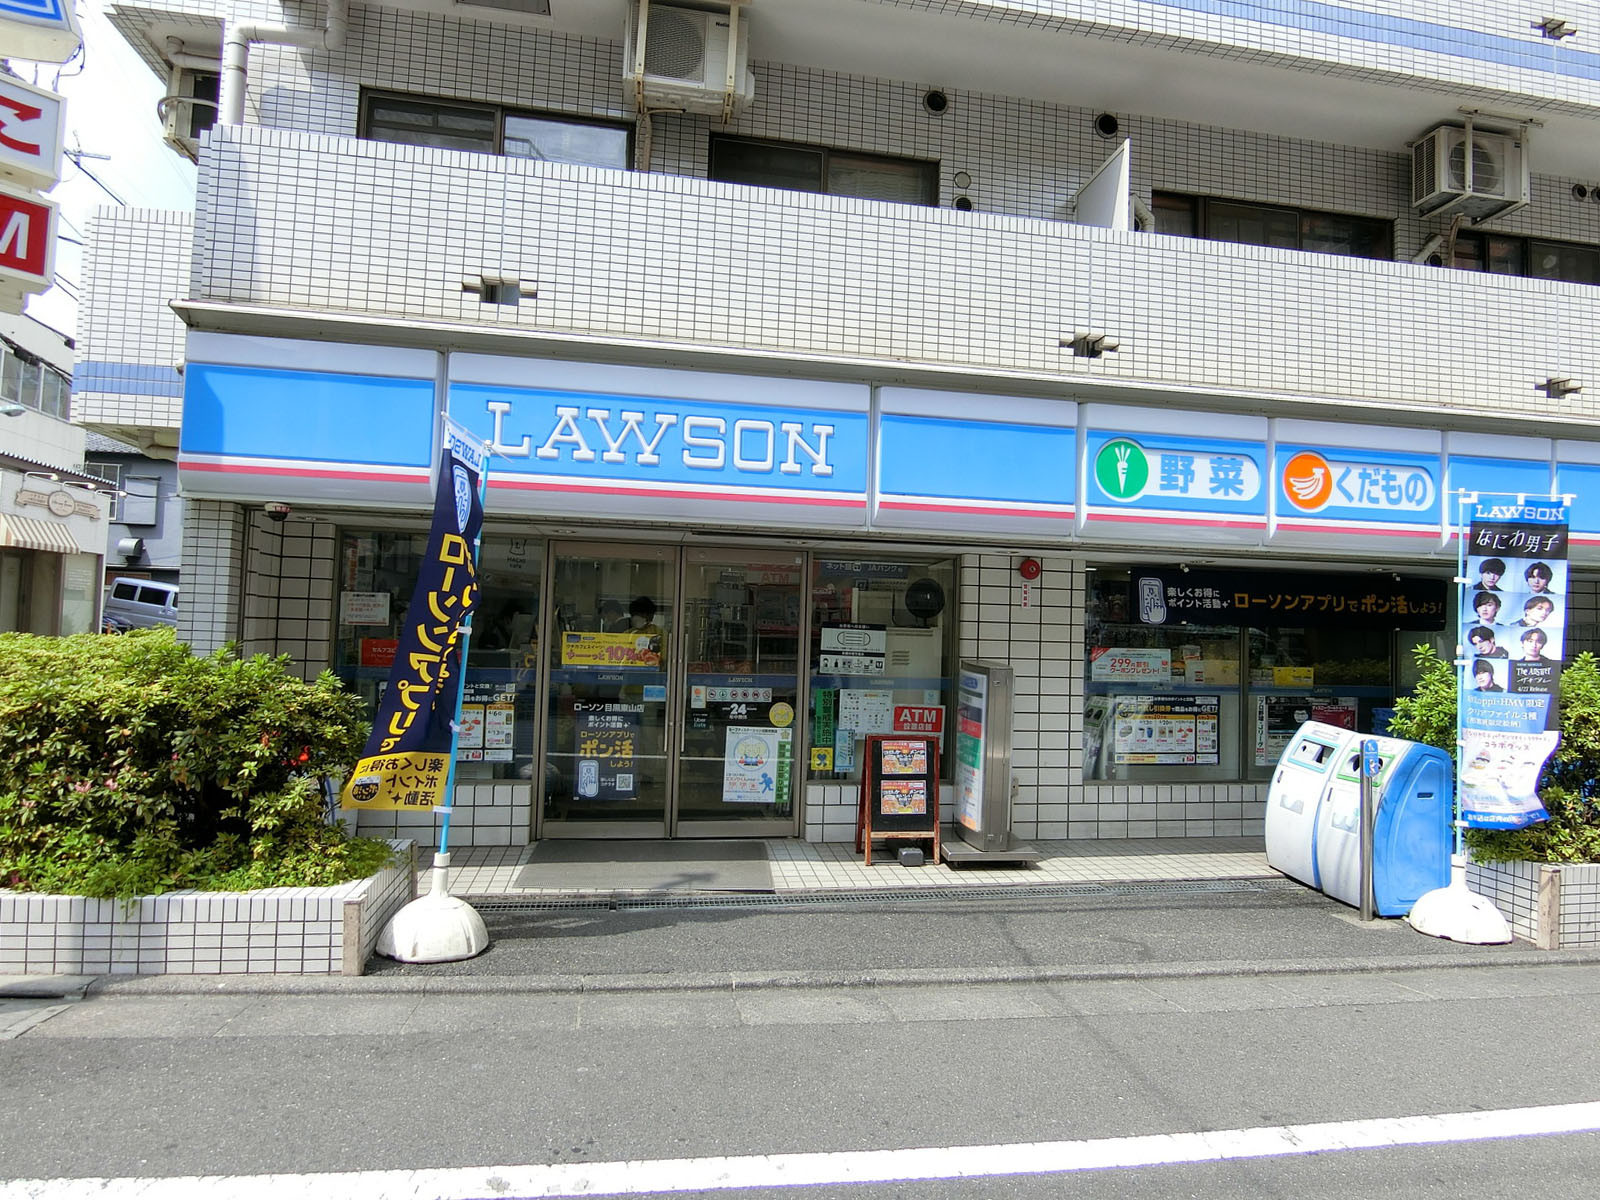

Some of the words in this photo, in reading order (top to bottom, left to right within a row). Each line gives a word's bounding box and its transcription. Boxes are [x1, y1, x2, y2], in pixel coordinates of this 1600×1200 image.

[486, 400, 835, 477] LAWSON
[1159, 453, 1245, 497] 野菜
[1335, 466, 1428, 507] くだもの
[1475, 504, 1565, 521] LAWSON
[1476, 528, 1560, 553] なにわ男子
[1167, 587, 1221, 598] 楽しくお得に
[1168, 598, 1222, 609] ポイント活動
[1234, 593, 1443, 614] ローソンアプリでポン活しよう!
[730, 703, 747, 715] 24
[899, 708, 937, 723] ATM
[580, 739, 634, 758] ポン活
[610, 760, 634, 768] しよう!
